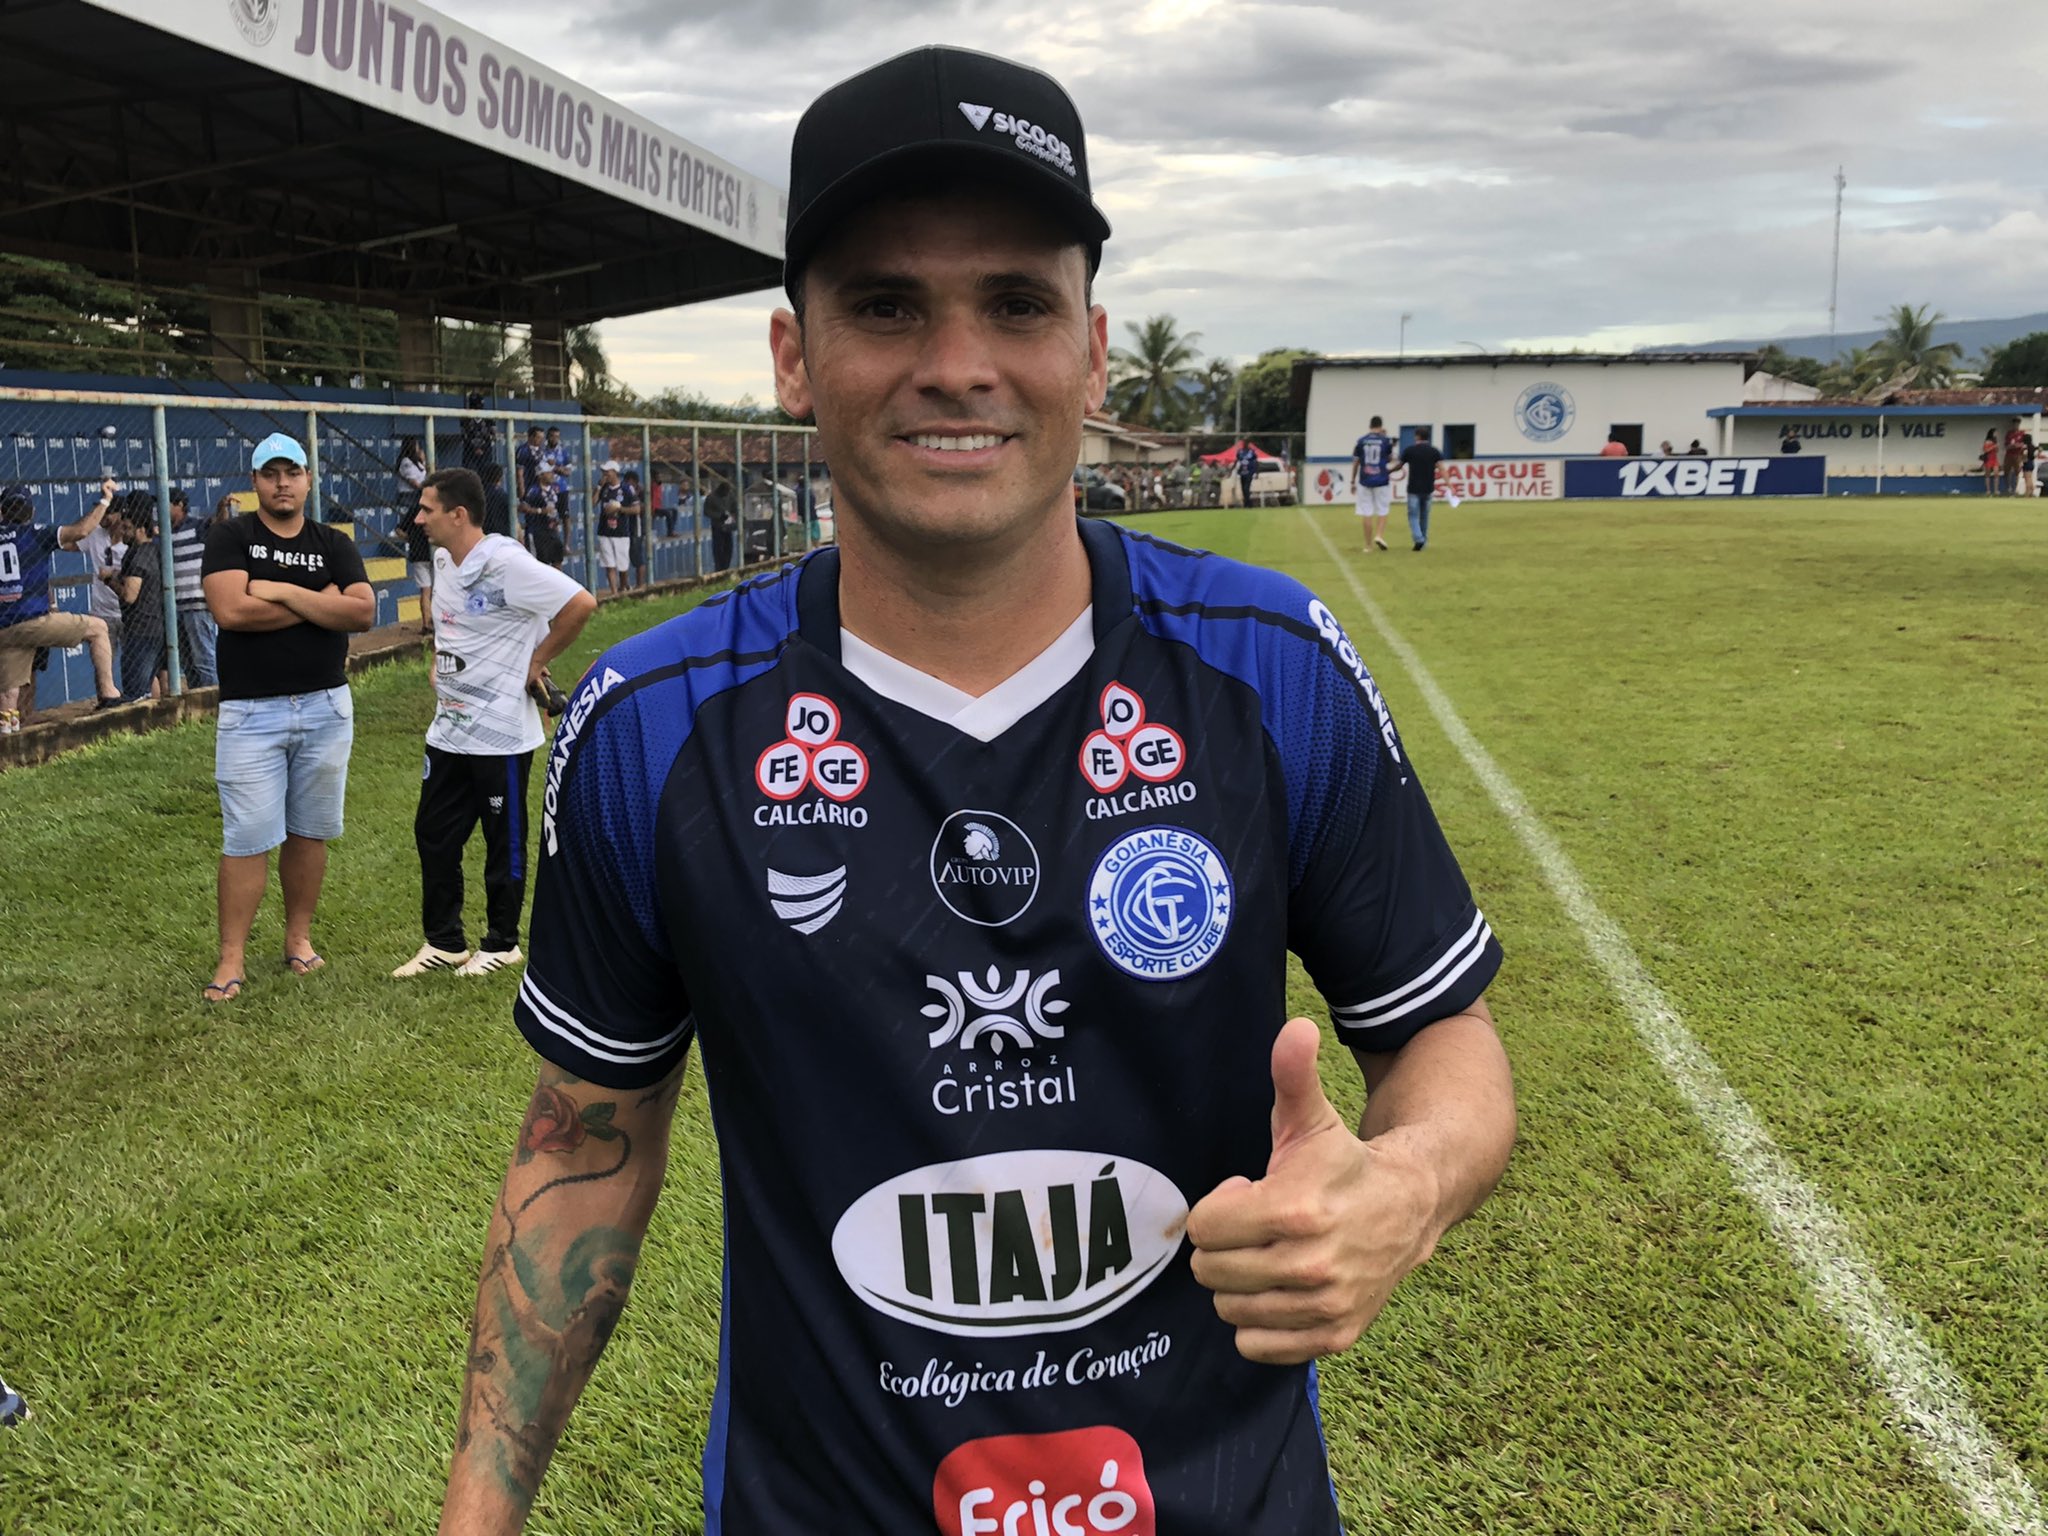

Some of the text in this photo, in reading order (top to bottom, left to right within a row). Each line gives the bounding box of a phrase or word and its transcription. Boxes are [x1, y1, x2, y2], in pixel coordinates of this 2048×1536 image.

[294, 0, 468, 117] JUNTOS
[477, 52, 594, 168] SOMOS
[599, 112, 662, 197] MAIS
[666, 146, 742, 230] FORTES!
[992, 112, 1073, 164] SICOOB
[1861, 422, 1889, 439] DO
[1901, 421, 1946, 438] VALE
[1363, 444, 1382, 465] 10
[1434, 463, 1546, 481] ANGUE
[1493, 480, 1553, 496] TIME
[1618, 459, 1769, 496] 1XBET
[792, 706, 830, 735] JO
[769, 754, 857, 784] FE GE
[1092, 737, 1177, 775] FE GE
[753, 797, 868, 828] CALCÁRIO
[1085, 781, 1197, 820] CALCÁRIO
[1104, 831, 1209, 874] GOIANÉSIA
[937, 861, 1036, 886] AUTOVIP
[1104, 920, 1224, 974] ESPORTE CLUBE
[932, 1066, 1076, 1115] Cristal
[897, 1160, 1134, 1306] ITAJÁ
[879, 1331, 1171, 1408] Ecológica de Coração
[959, 1459, 1137, 1536] Fricó
